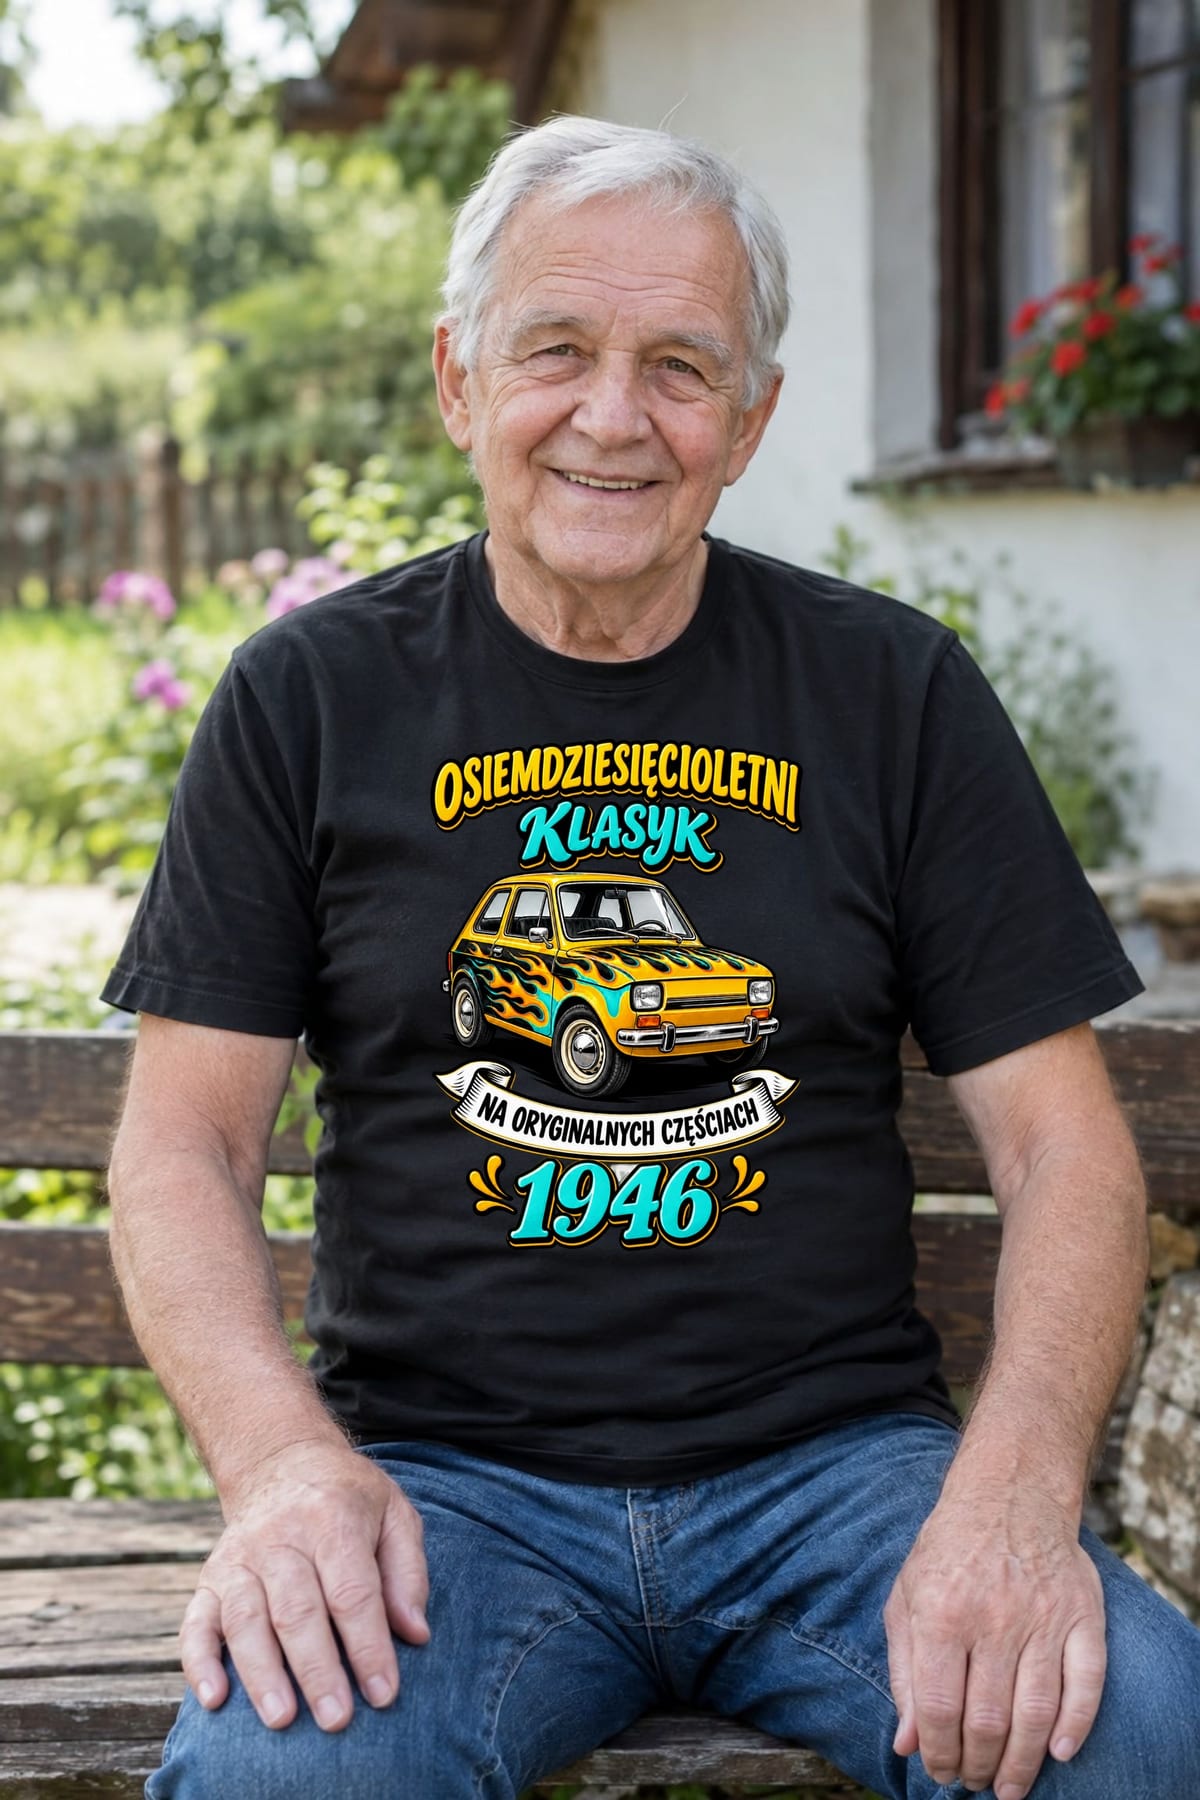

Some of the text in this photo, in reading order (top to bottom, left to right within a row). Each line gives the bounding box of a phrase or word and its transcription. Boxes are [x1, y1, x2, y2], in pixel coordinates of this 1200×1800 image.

[434, 742, 799, 823] OSIEMDZIESIĘCIOLETNI
[519, 801, 716, 866] KLASYK
[477, 1092, 760, 1146] NA ORYGINALNYCH CZĘŚCIACH
[510, 1160, 714, 1240] 1946
